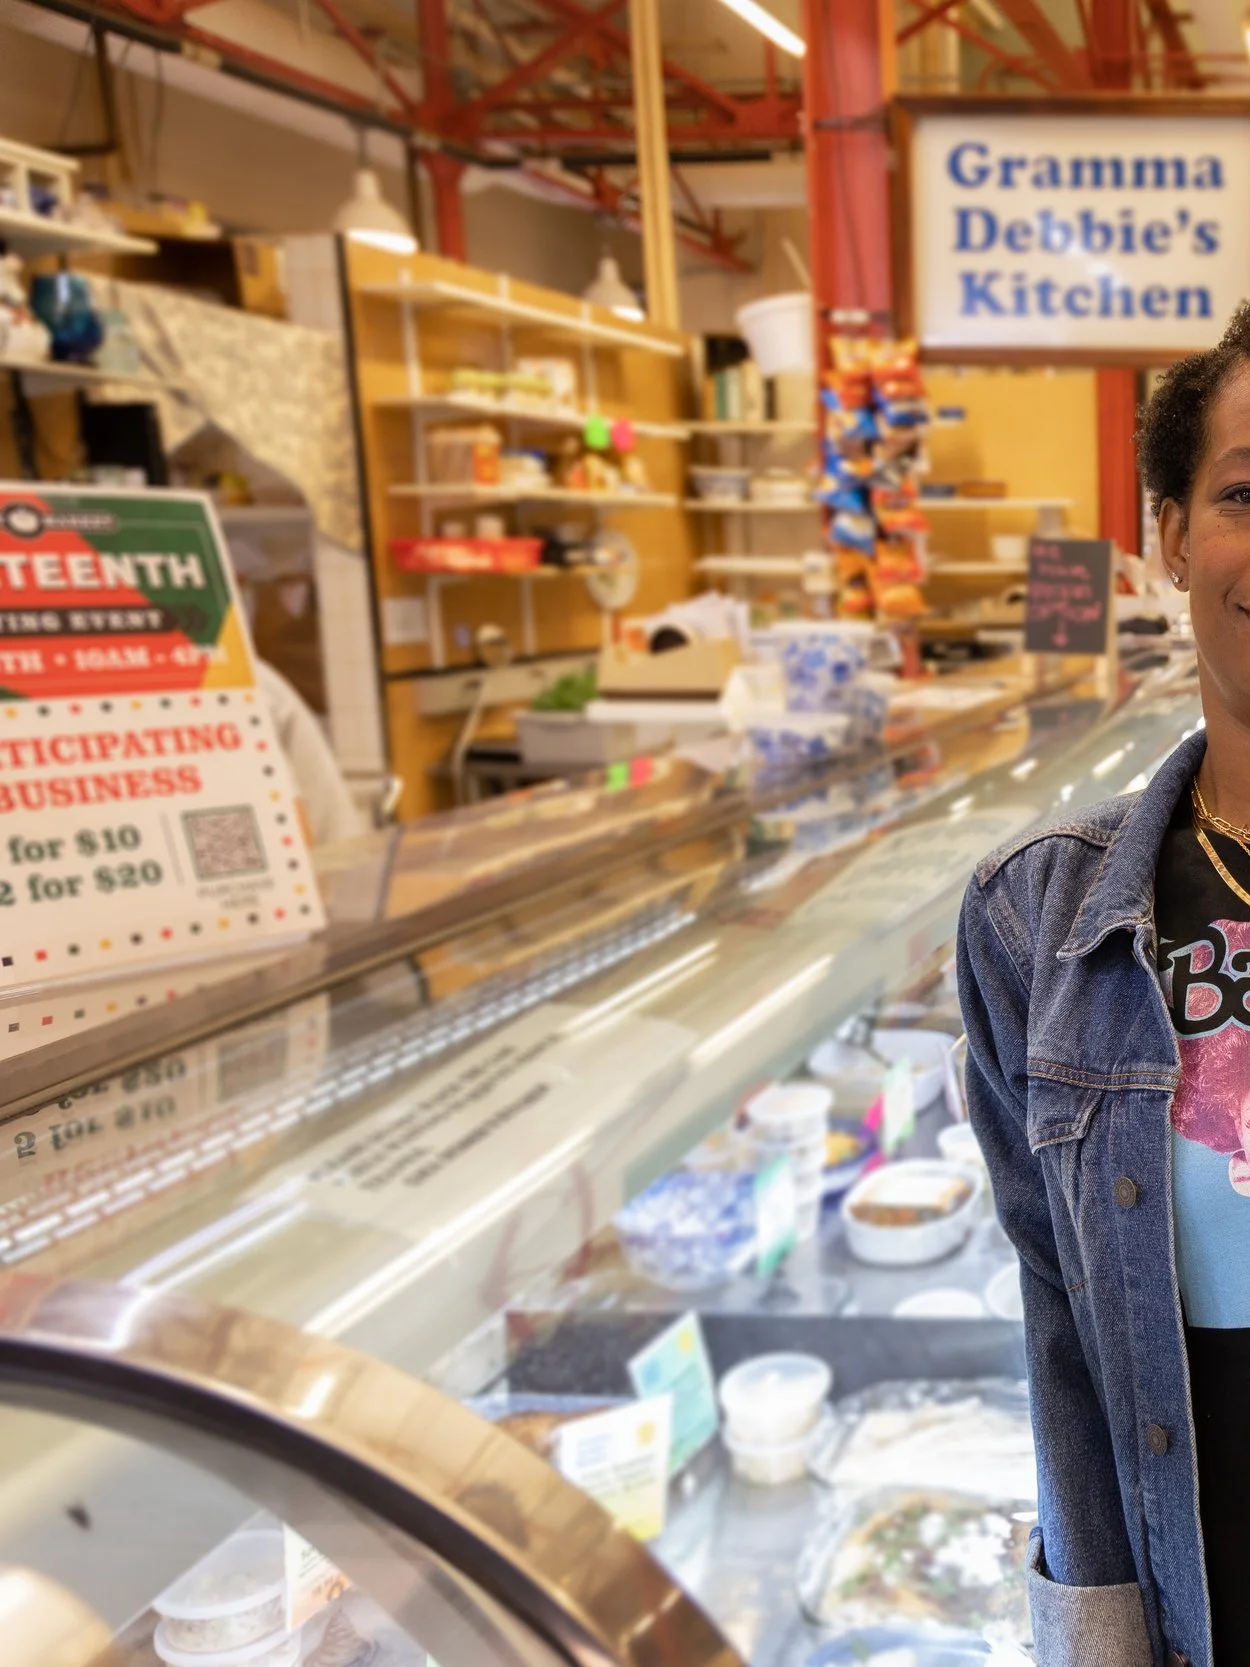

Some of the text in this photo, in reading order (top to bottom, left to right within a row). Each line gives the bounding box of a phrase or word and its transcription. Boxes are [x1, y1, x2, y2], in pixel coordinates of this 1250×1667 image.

[947, 142, 1224, 190] Gramma
[954, 206, 1220, 253] Debbie's
[959, 271, 1212, 318] Kitchen
[69, 609, 163, 631] EVENT
[74, 646, 150, 671] 10AM
[8, 824, 142, 865] for $10
[27, 872, 83, 903] for
[94, 858, 163, 894] $20
